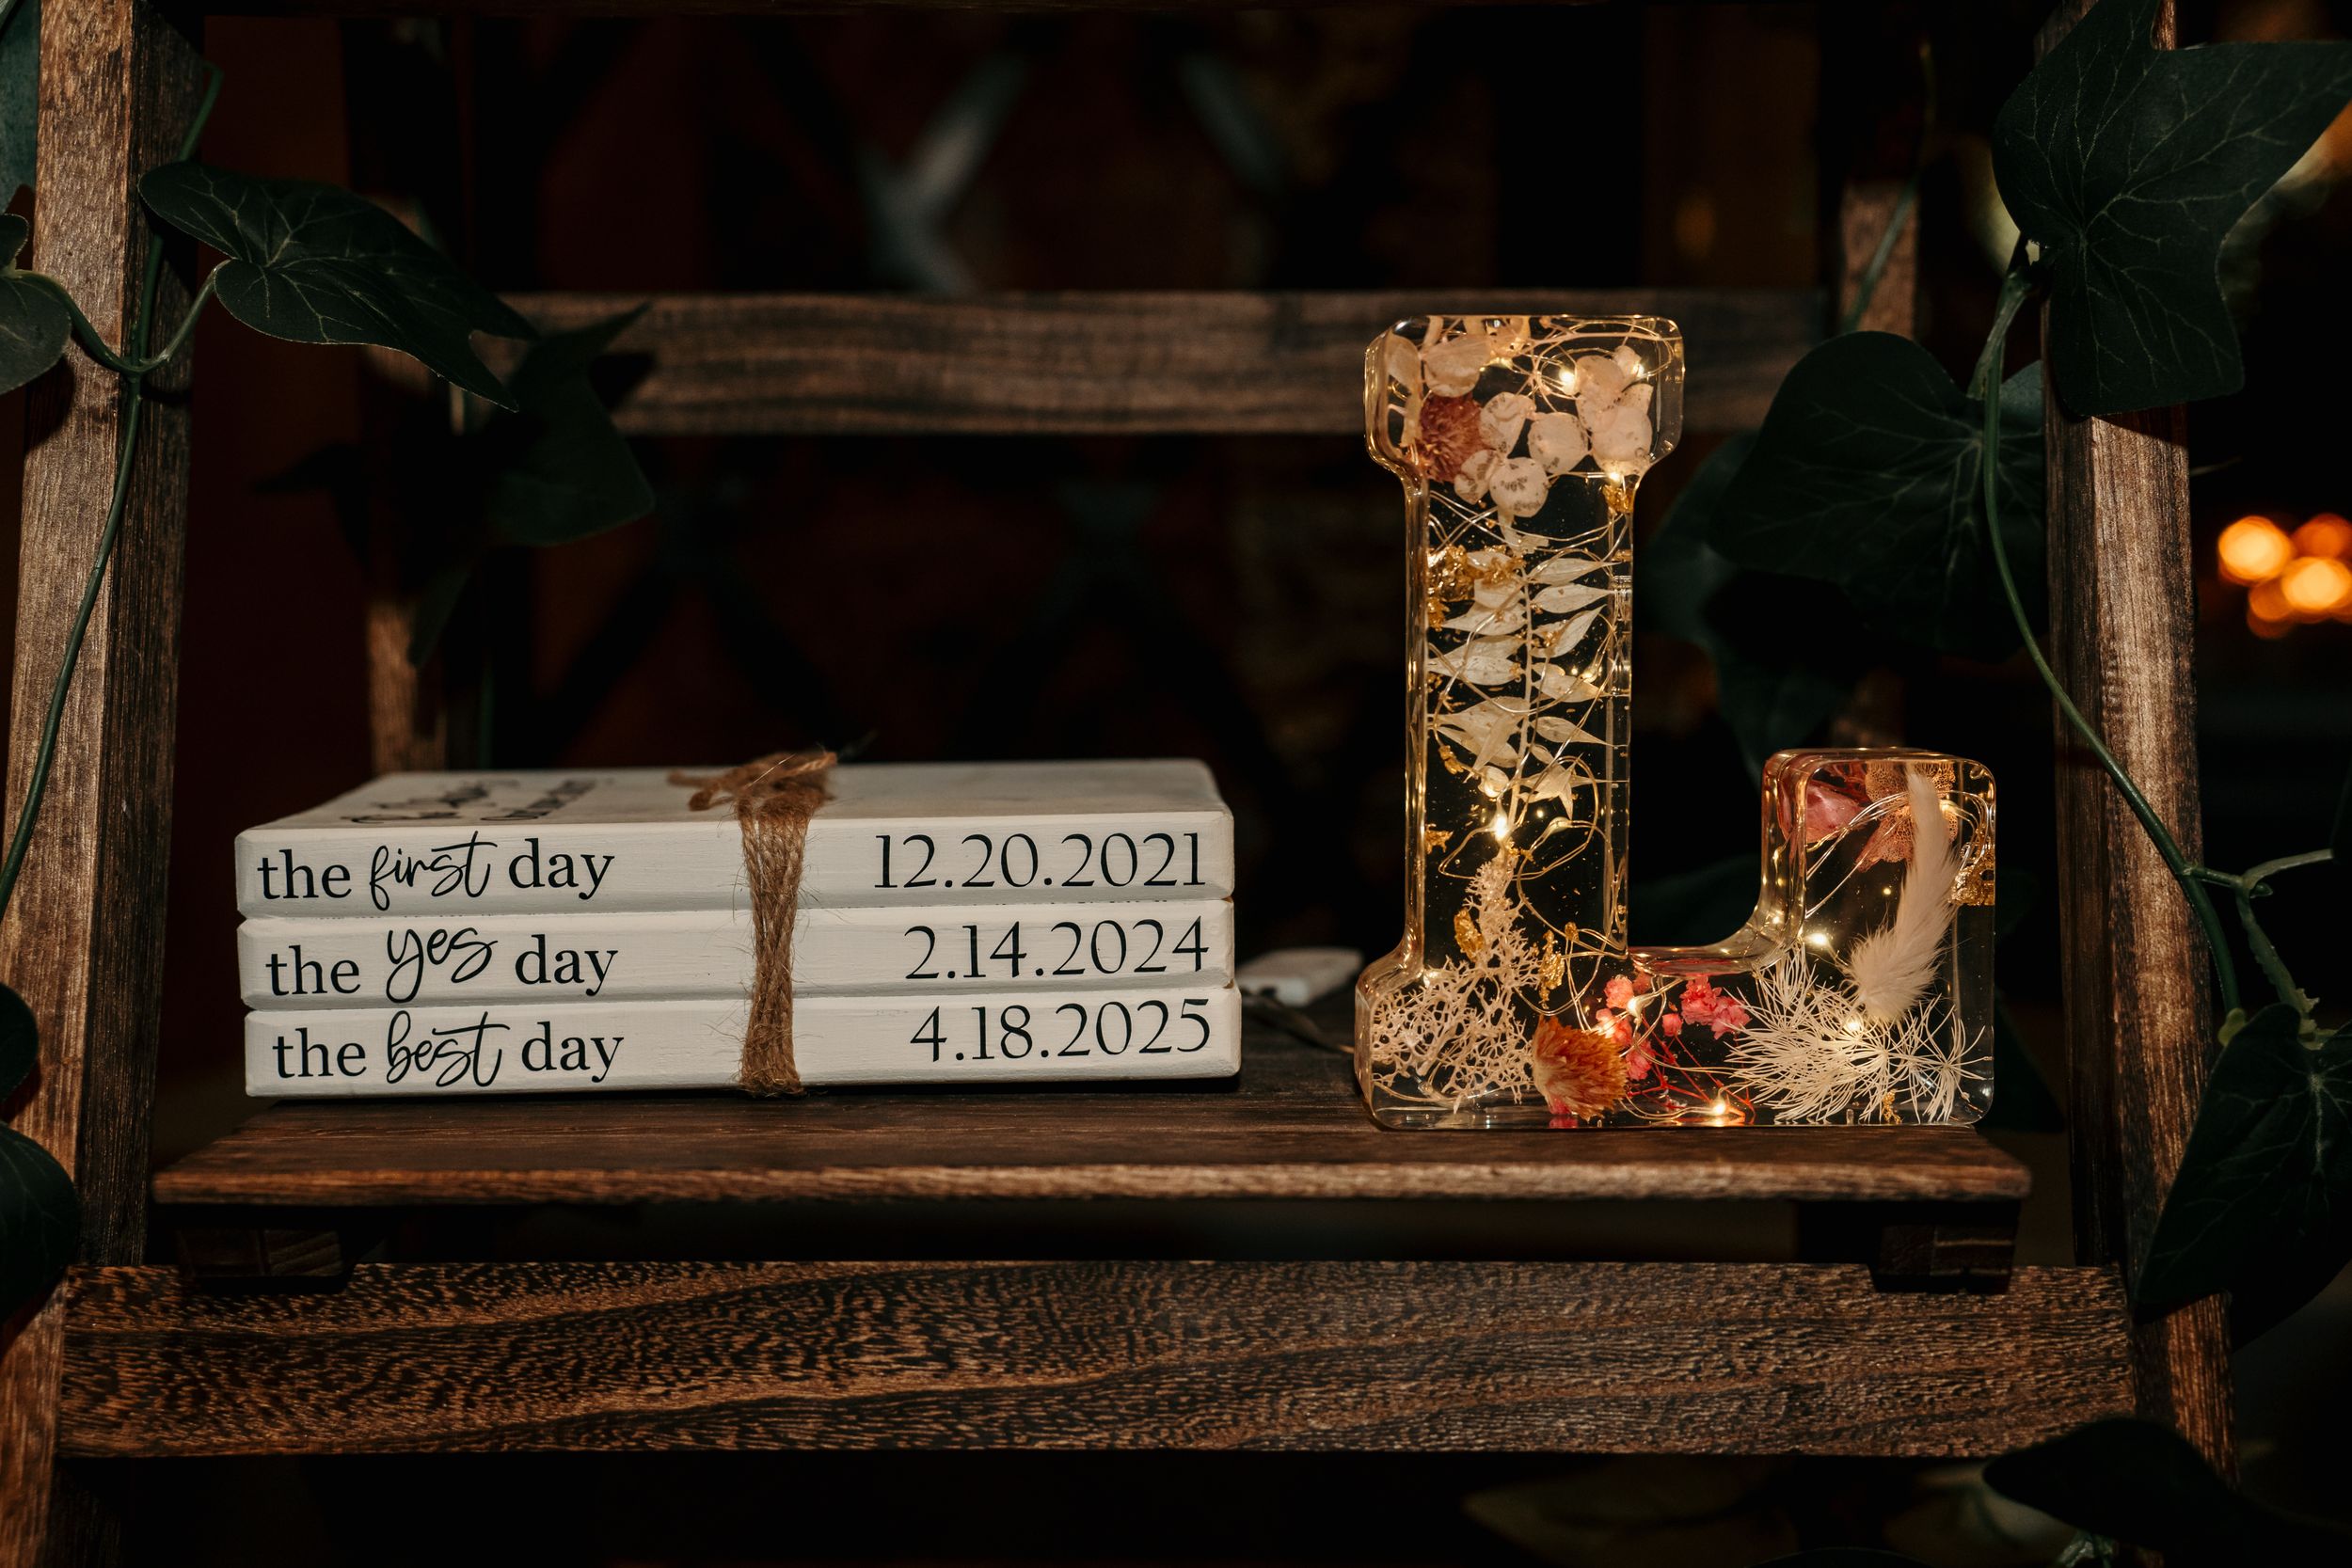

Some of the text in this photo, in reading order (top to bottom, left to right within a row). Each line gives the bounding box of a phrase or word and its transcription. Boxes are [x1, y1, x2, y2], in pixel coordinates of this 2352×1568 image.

[257, 831, 1206, 911] the first day 12.20.2021
[265, 915, 1210, 1004] the yes day 2.14.2024
[272, 998, 1211, 1087] the best day 4.18.2025
